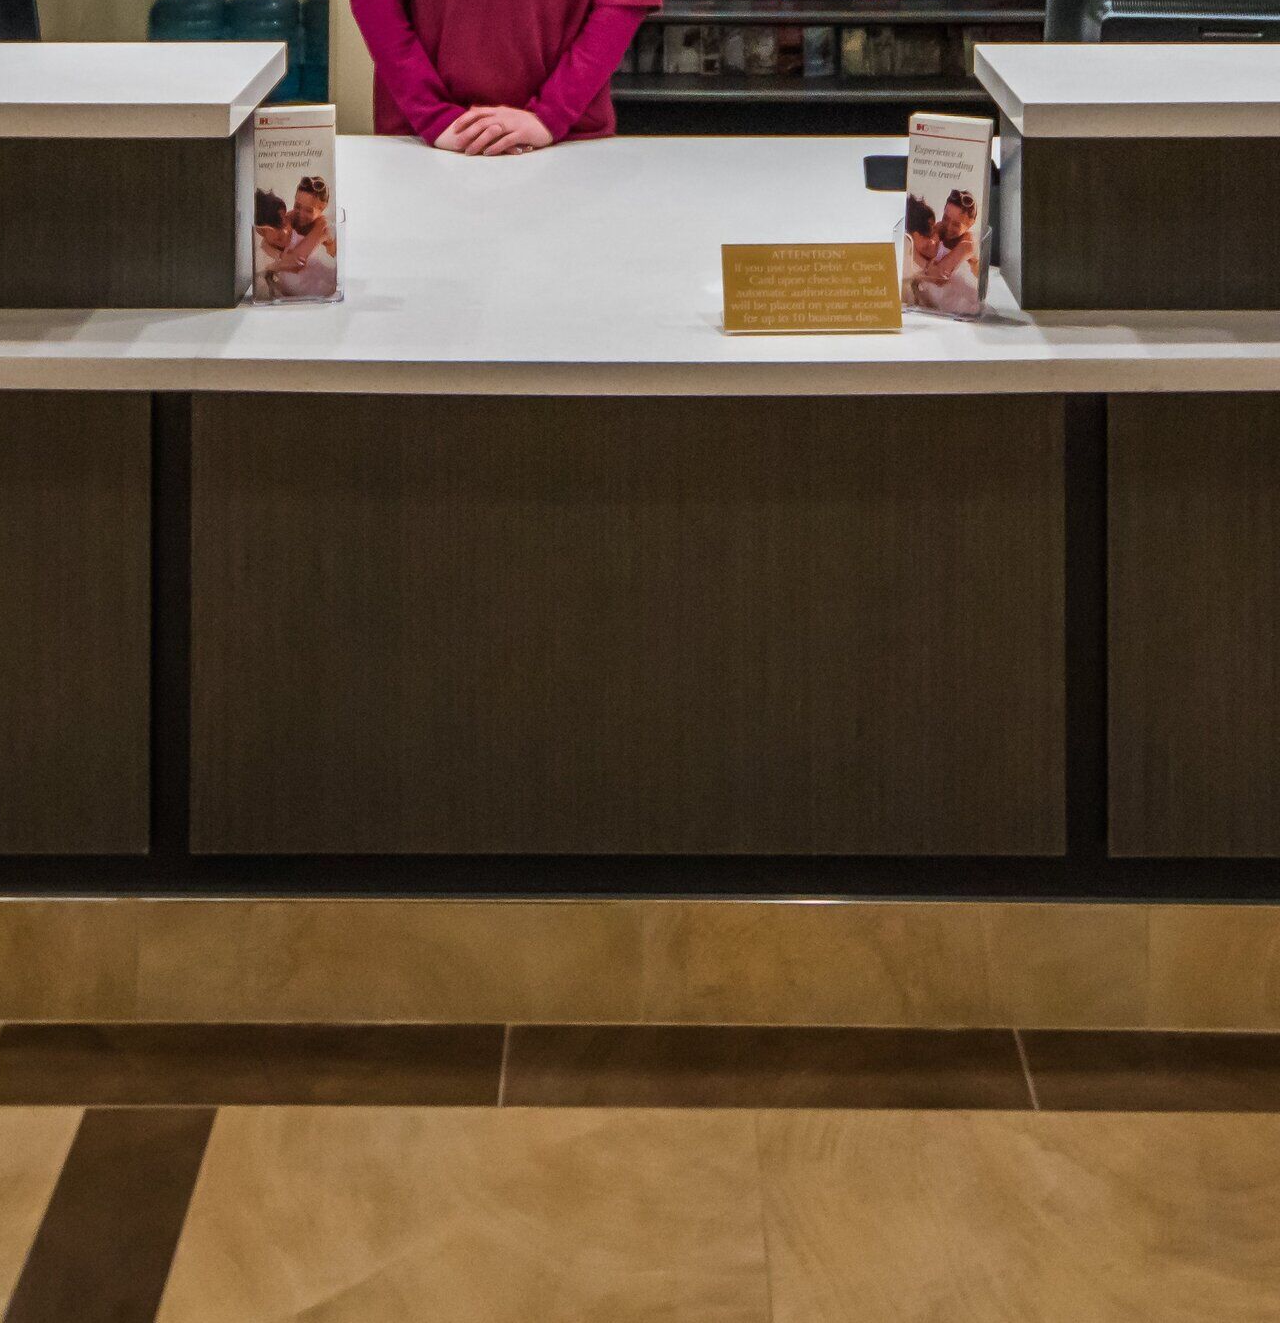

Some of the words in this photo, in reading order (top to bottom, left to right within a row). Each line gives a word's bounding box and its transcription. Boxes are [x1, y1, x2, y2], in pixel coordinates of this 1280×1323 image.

[259, 139, 302, 148] Experience
[281, 148, 323, 157] rewarding
[914, 145, 956, 156] Experience
[259, 162, 274, 170] way
[286, 159, 310, 168] travel
[913, 157, 932, 165] more
[934, 160, 974, 172] rewarding
[913, 168, 928, 176] way
[929, 168, 936, 176] to
[938, 171, 961, 179] travel
[772, 249, 846, 260] ATTENTION!
[735, 263, 742, 273] If
[745, 265, 763, 274] you
[787, 264, 811, 274] your
[814, 262, 842, 272] Debit
[852, 262, 885, 272] Check
[749, 276, 774, 285] Card
[777, 276, 804, 286] upon
[858, 275, 871, 283] an
[736, 288, 786, 298] automatic
[790, 286, 859, 297] authorization
[863, 286, 887, 296] hold
[731, 300, 751, 310] will
[754, 300, 768, 309] be
[770, 299, 805, 311] placed
[808, 301, 820, 309] on
[825, 300, 848, 310] your
[851, 299, 893, 309] account
[743, 313, 758, 323] for
[761, 314, 775, 324] up
[778, 313, 789, 322] to
[793, 312, 806, 322] 10
[808, 312, 853, 322] business
